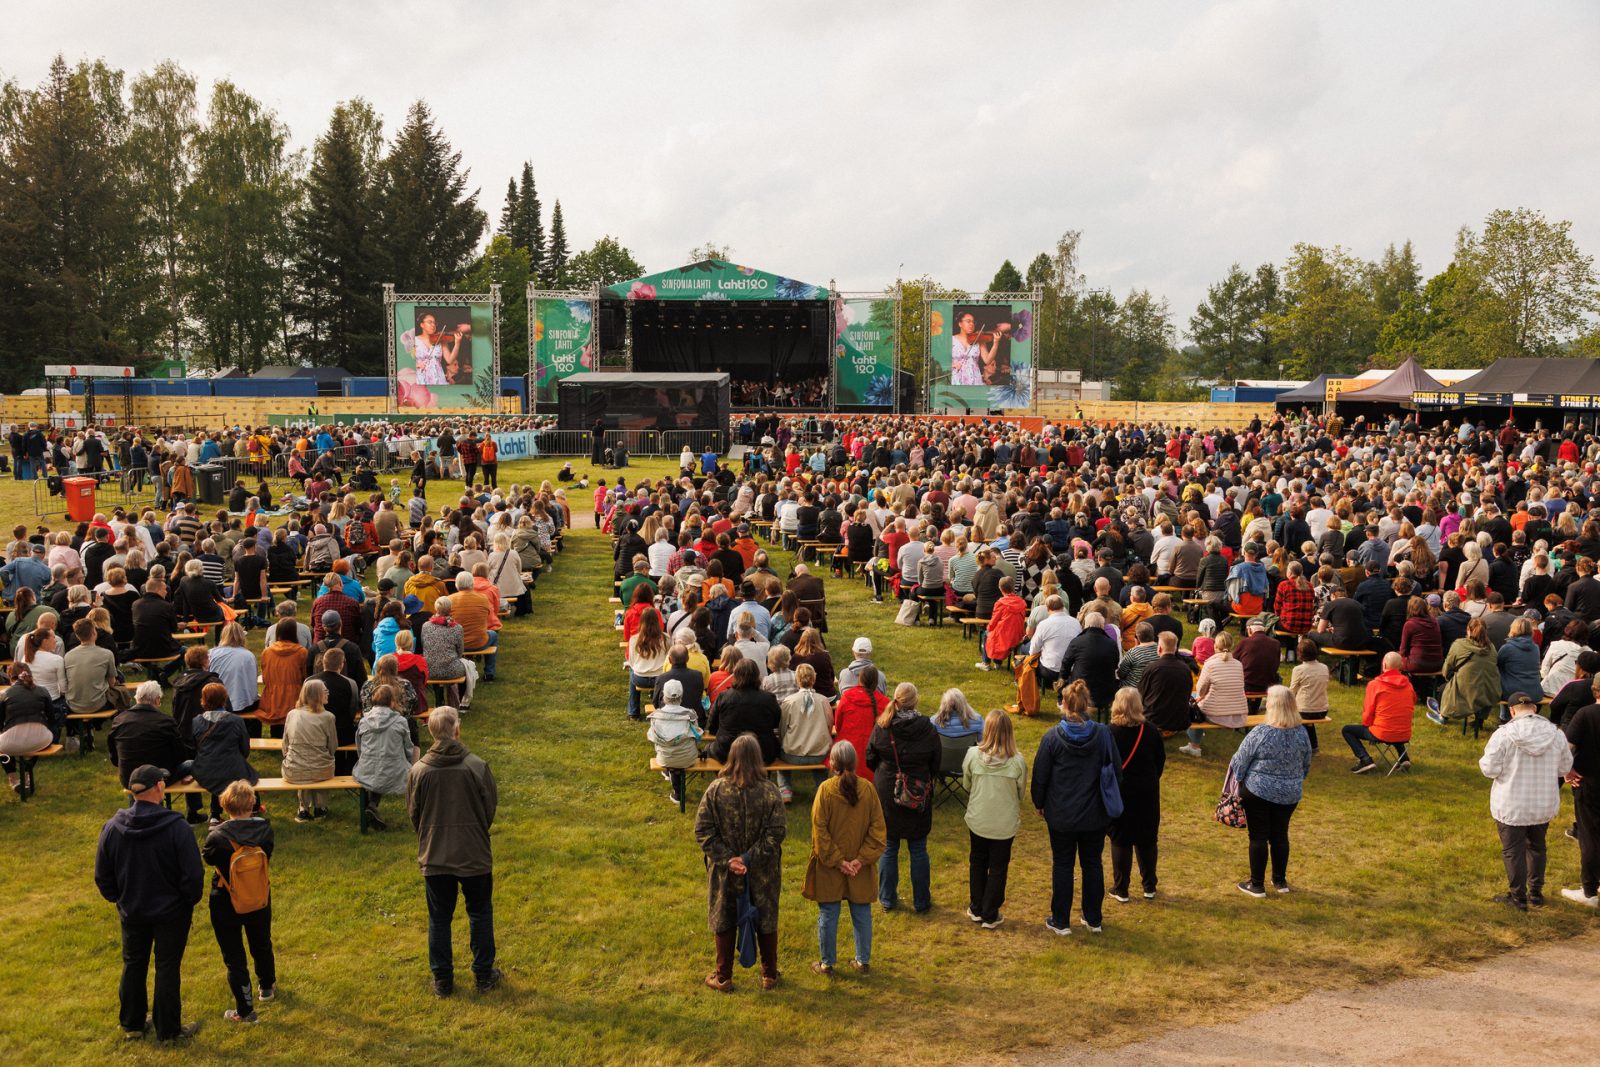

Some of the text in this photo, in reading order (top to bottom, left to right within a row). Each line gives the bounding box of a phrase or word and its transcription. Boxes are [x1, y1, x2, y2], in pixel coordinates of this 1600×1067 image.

[662, 279, 692, 290] SINFONIA
[693, 279, 711, 289] LAHTI
[548, 329, 579, 340] SINFONIA
[850, 331, 880, 341] SINFONIA
[555, 340, 573, 350] LAHTI
[856, 341, 874, 351] LAHTI
[551, 354, 576, 362] Lahti
[852, 355, 877, 364] Lahti
[554, 363, 574, 372] 120
[854, 365, 875, 374] 120
[498, 436, 527, 455] Lahti
